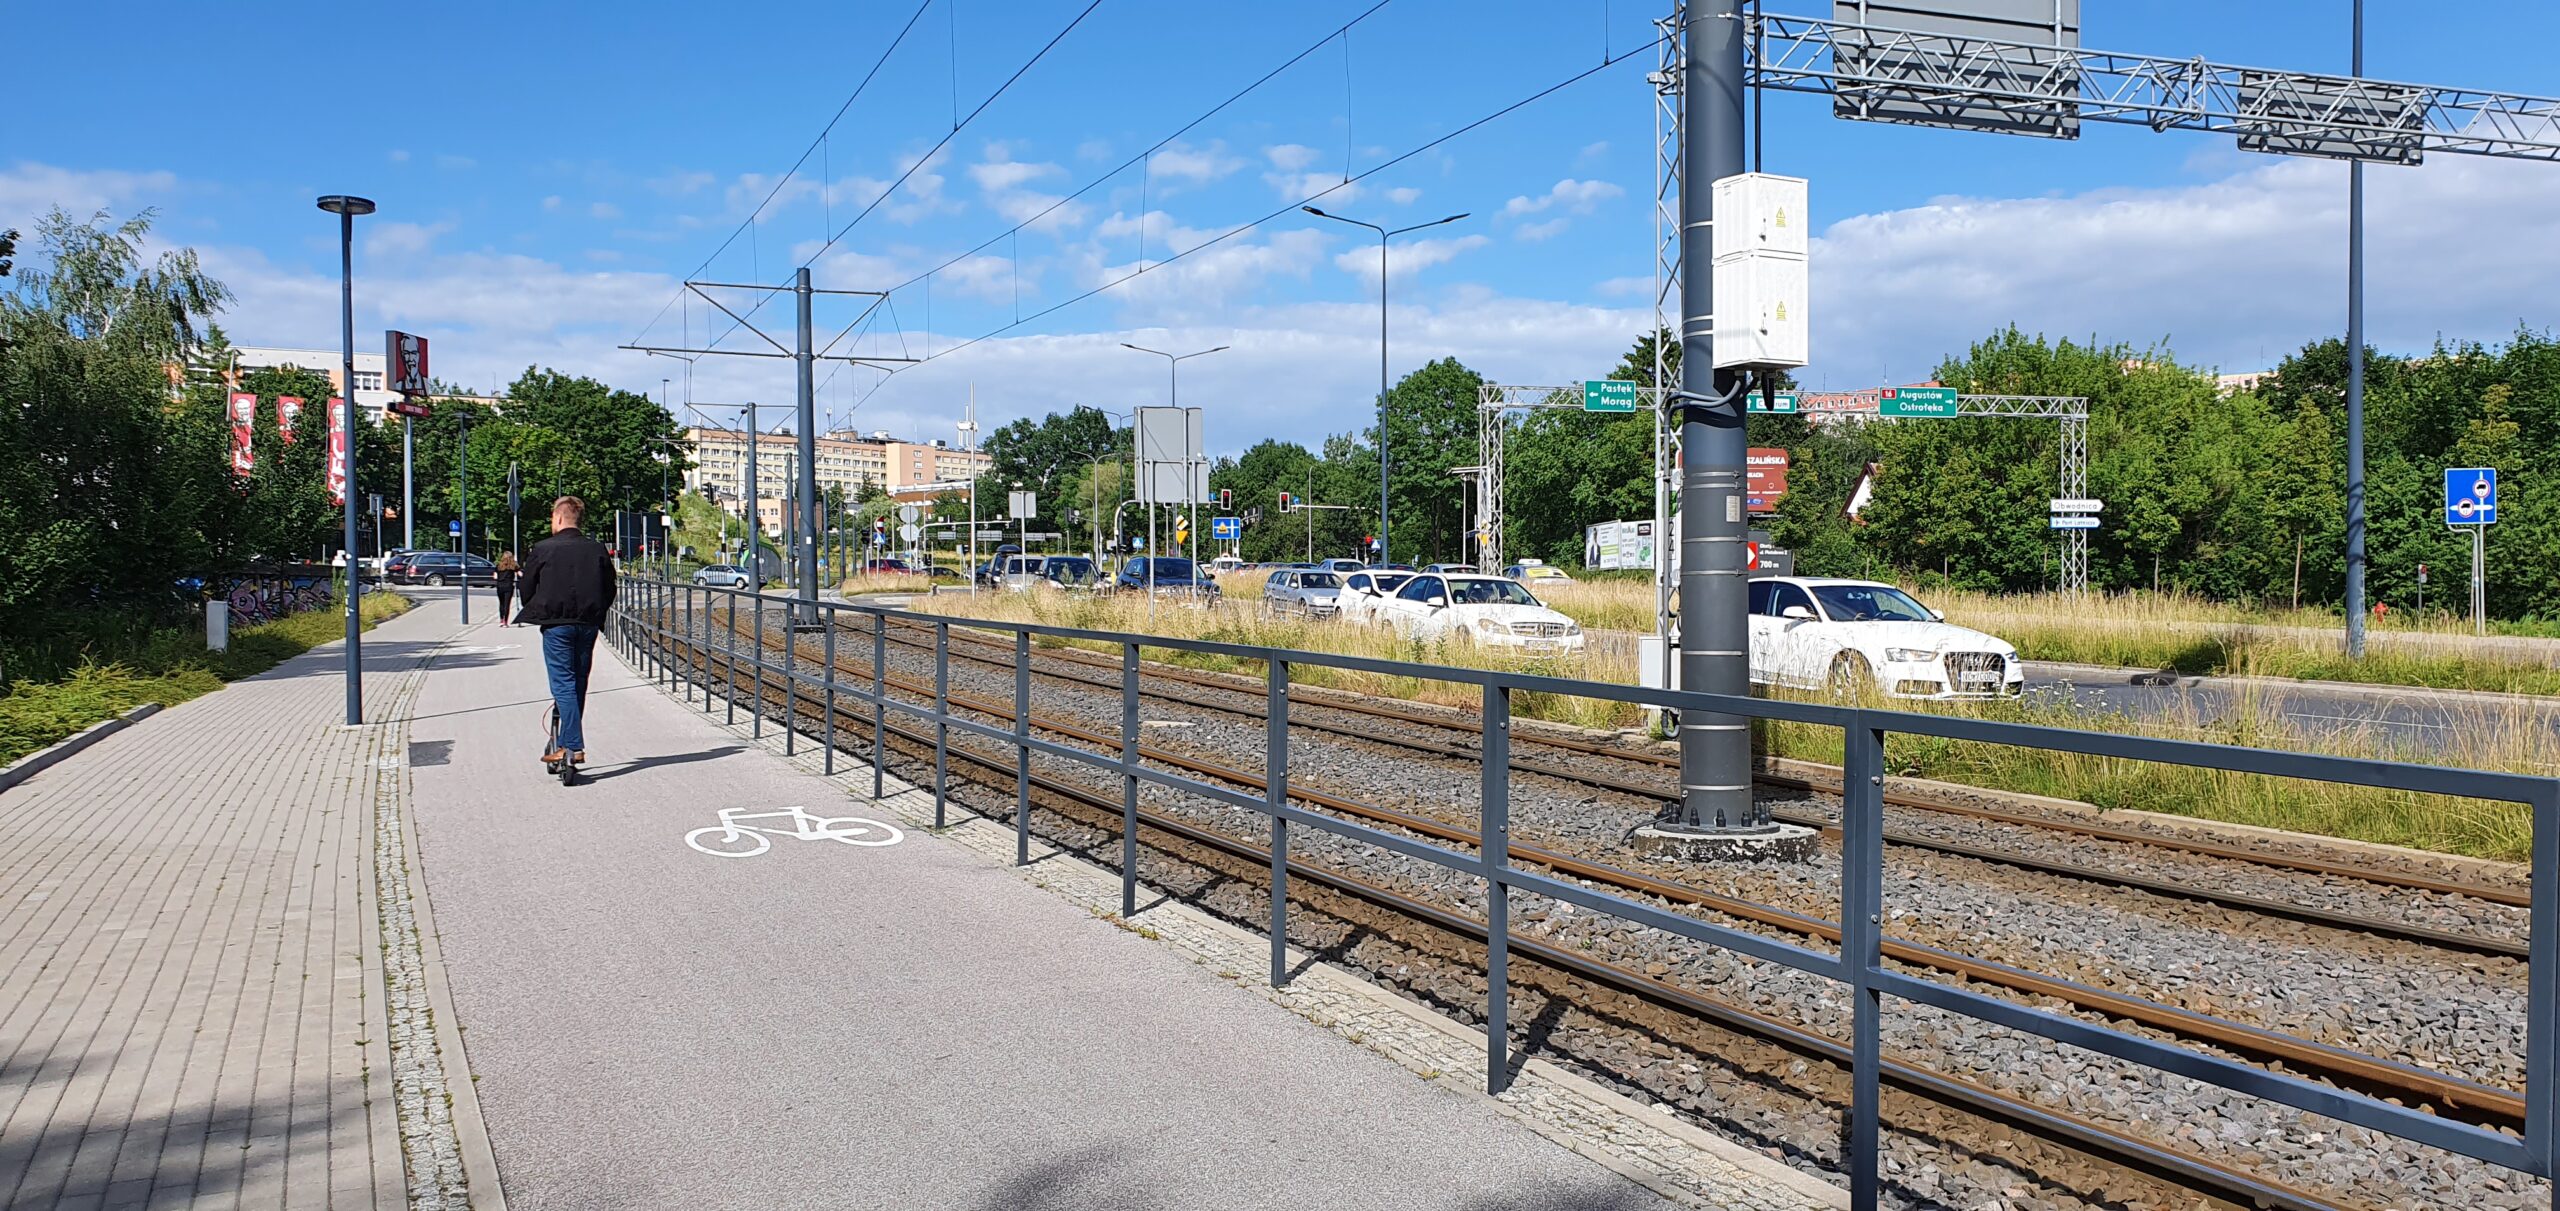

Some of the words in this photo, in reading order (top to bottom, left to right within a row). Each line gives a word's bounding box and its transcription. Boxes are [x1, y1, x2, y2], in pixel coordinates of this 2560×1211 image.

[1601, 383, 1632, 395] Pasłęk
[1900, 390, 1942, 401] Augustów
[1601, 396, 1632, 408] Morąg
[1900, 402, 1944, 413] Ostrołęka
[2054, 502, 2097, 510] Obwodnica
[1760, 560, 1773, 569] 700
